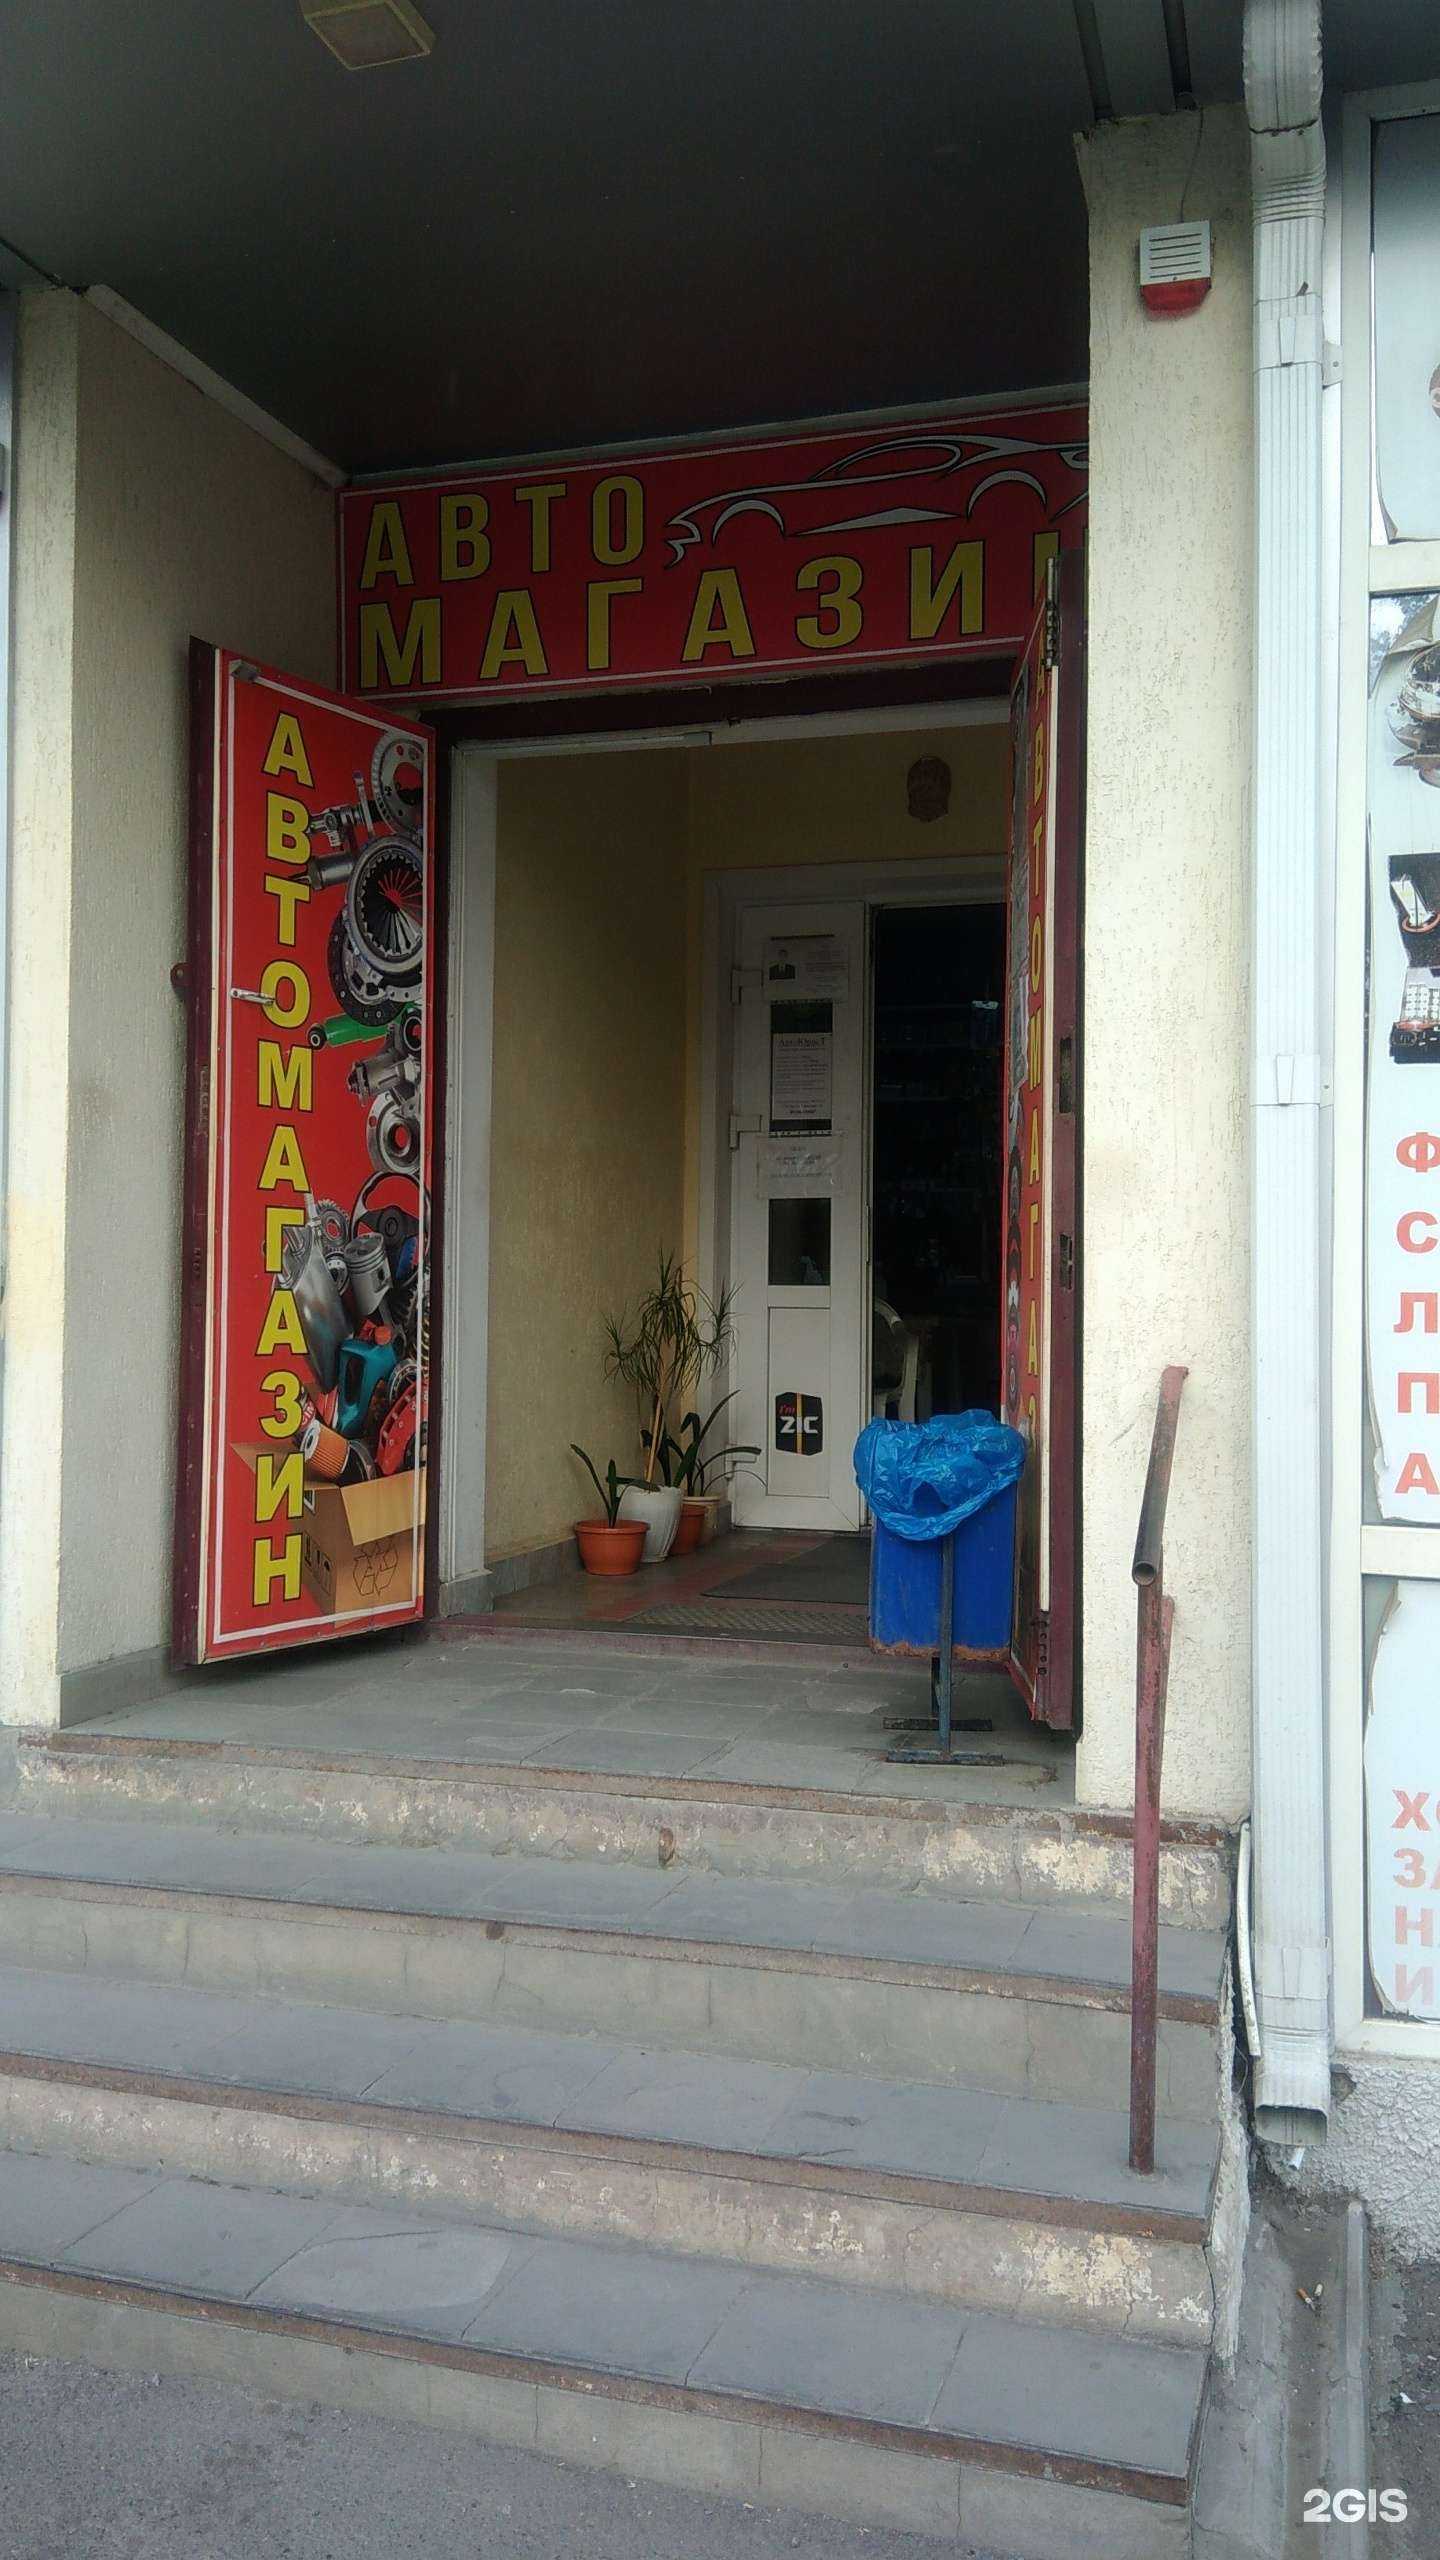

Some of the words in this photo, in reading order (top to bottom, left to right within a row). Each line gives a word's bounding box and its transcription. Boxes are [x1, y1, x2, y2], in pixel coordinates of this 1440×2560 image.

[359, 475, 646, 590] АВТО
[254, 712, 315, 1607] АВТОМАГАЗИН
[780, 1416, 819, 1434] ZIC
[1391, 1788, 1440, 1832] Х
